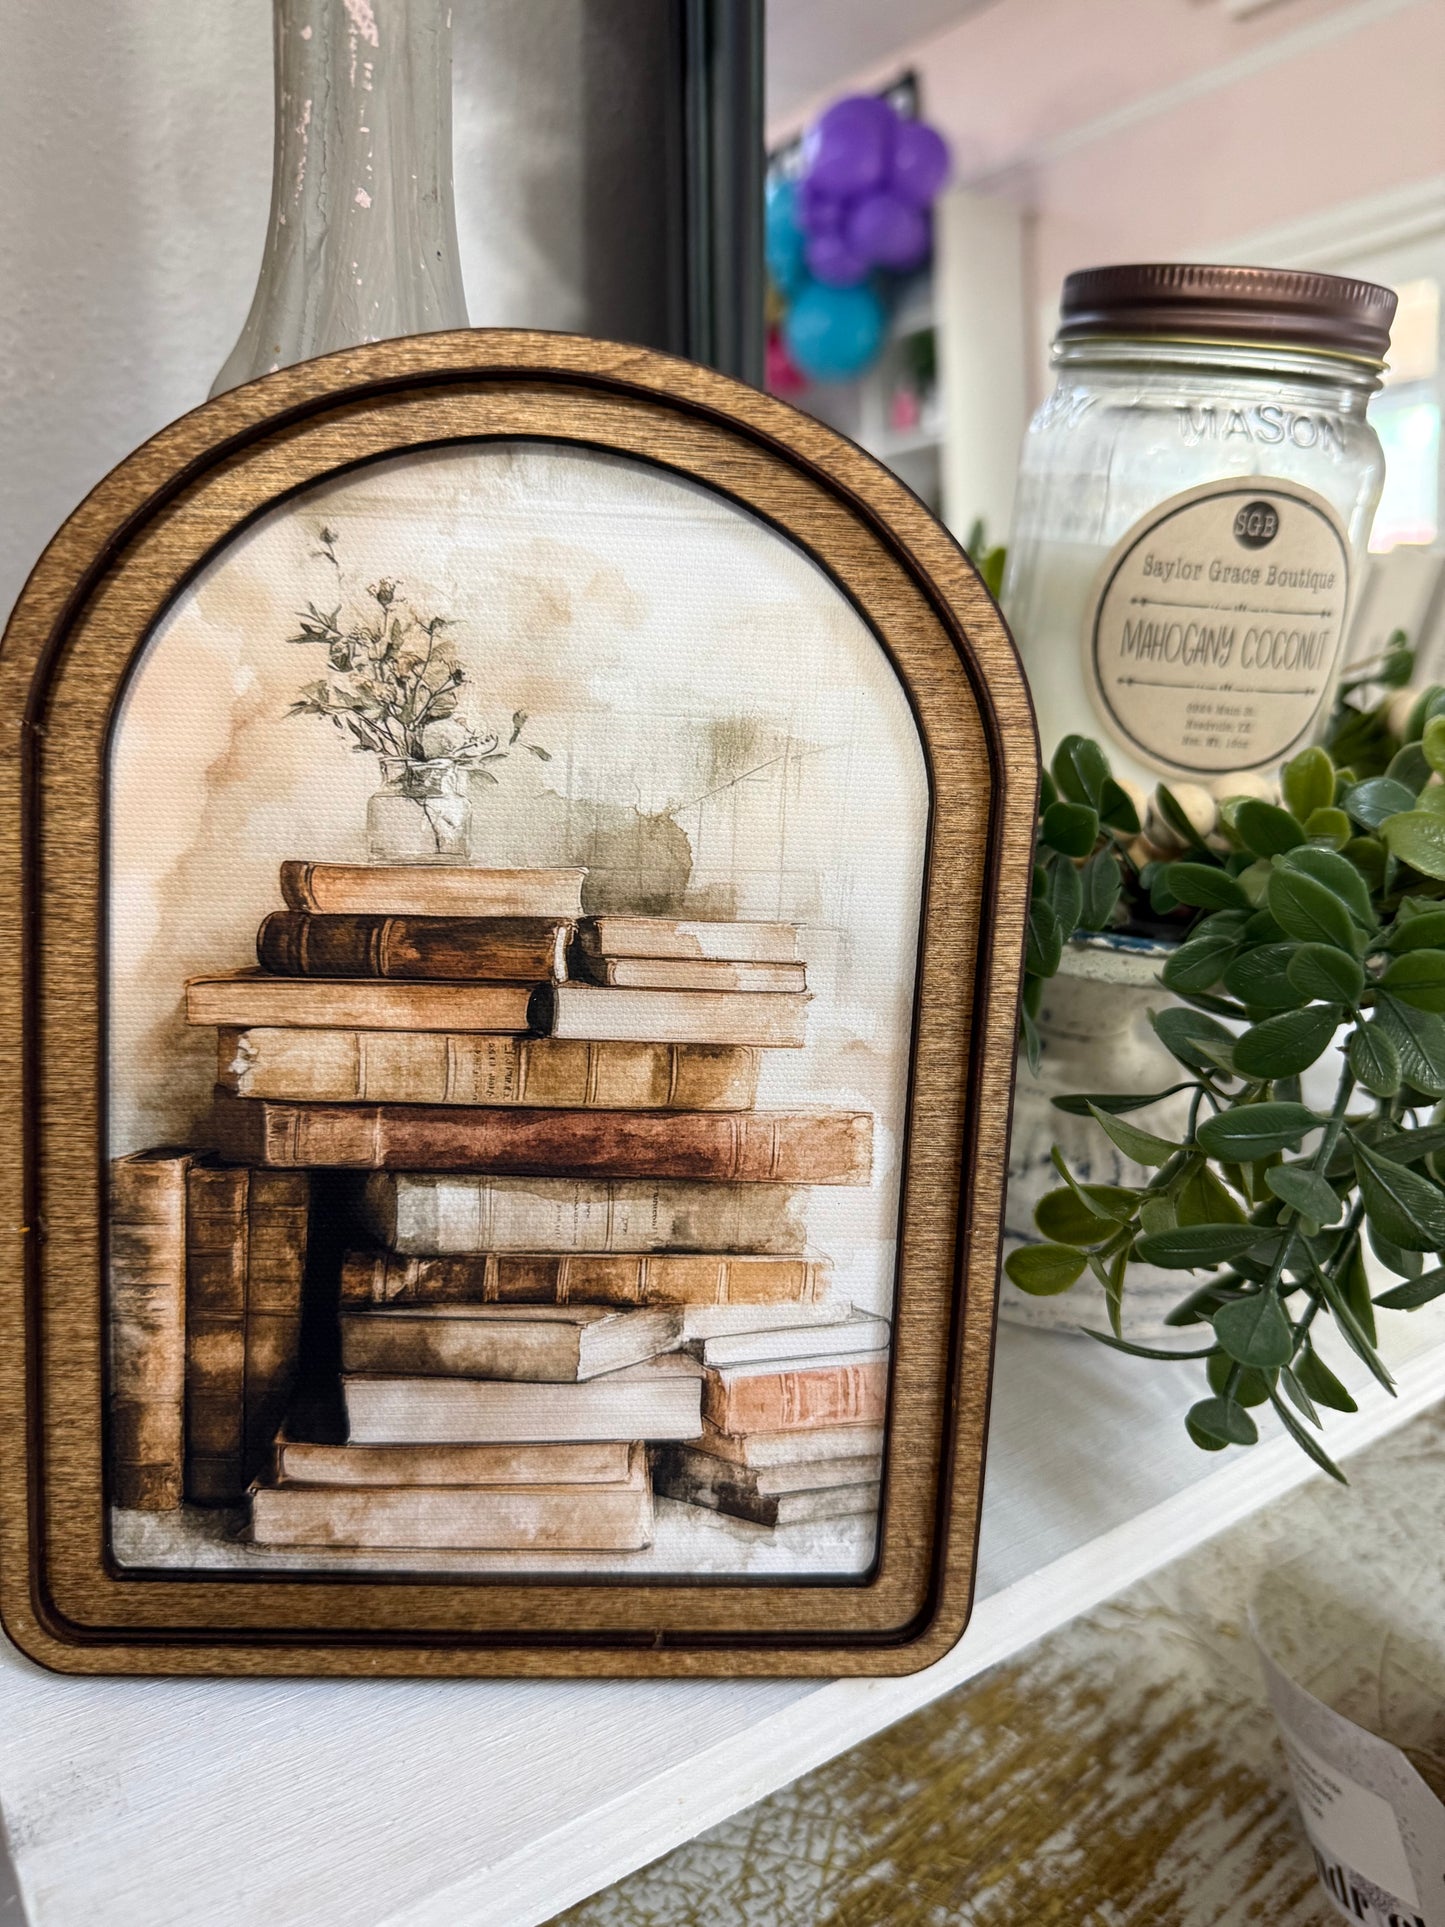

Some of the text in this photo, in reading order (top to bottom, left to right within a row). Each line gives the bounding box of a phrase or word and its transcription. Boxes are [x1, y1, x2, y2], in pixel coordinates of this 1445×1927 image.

[1175, 403, 1346, 455] MASON
[1233, 510, 1278, 538] SGB
[1143, 554, 1336, 594] Saylor Grace Boutique
[1120, 618, 1331, 671] MAHOGANY COCONUT
